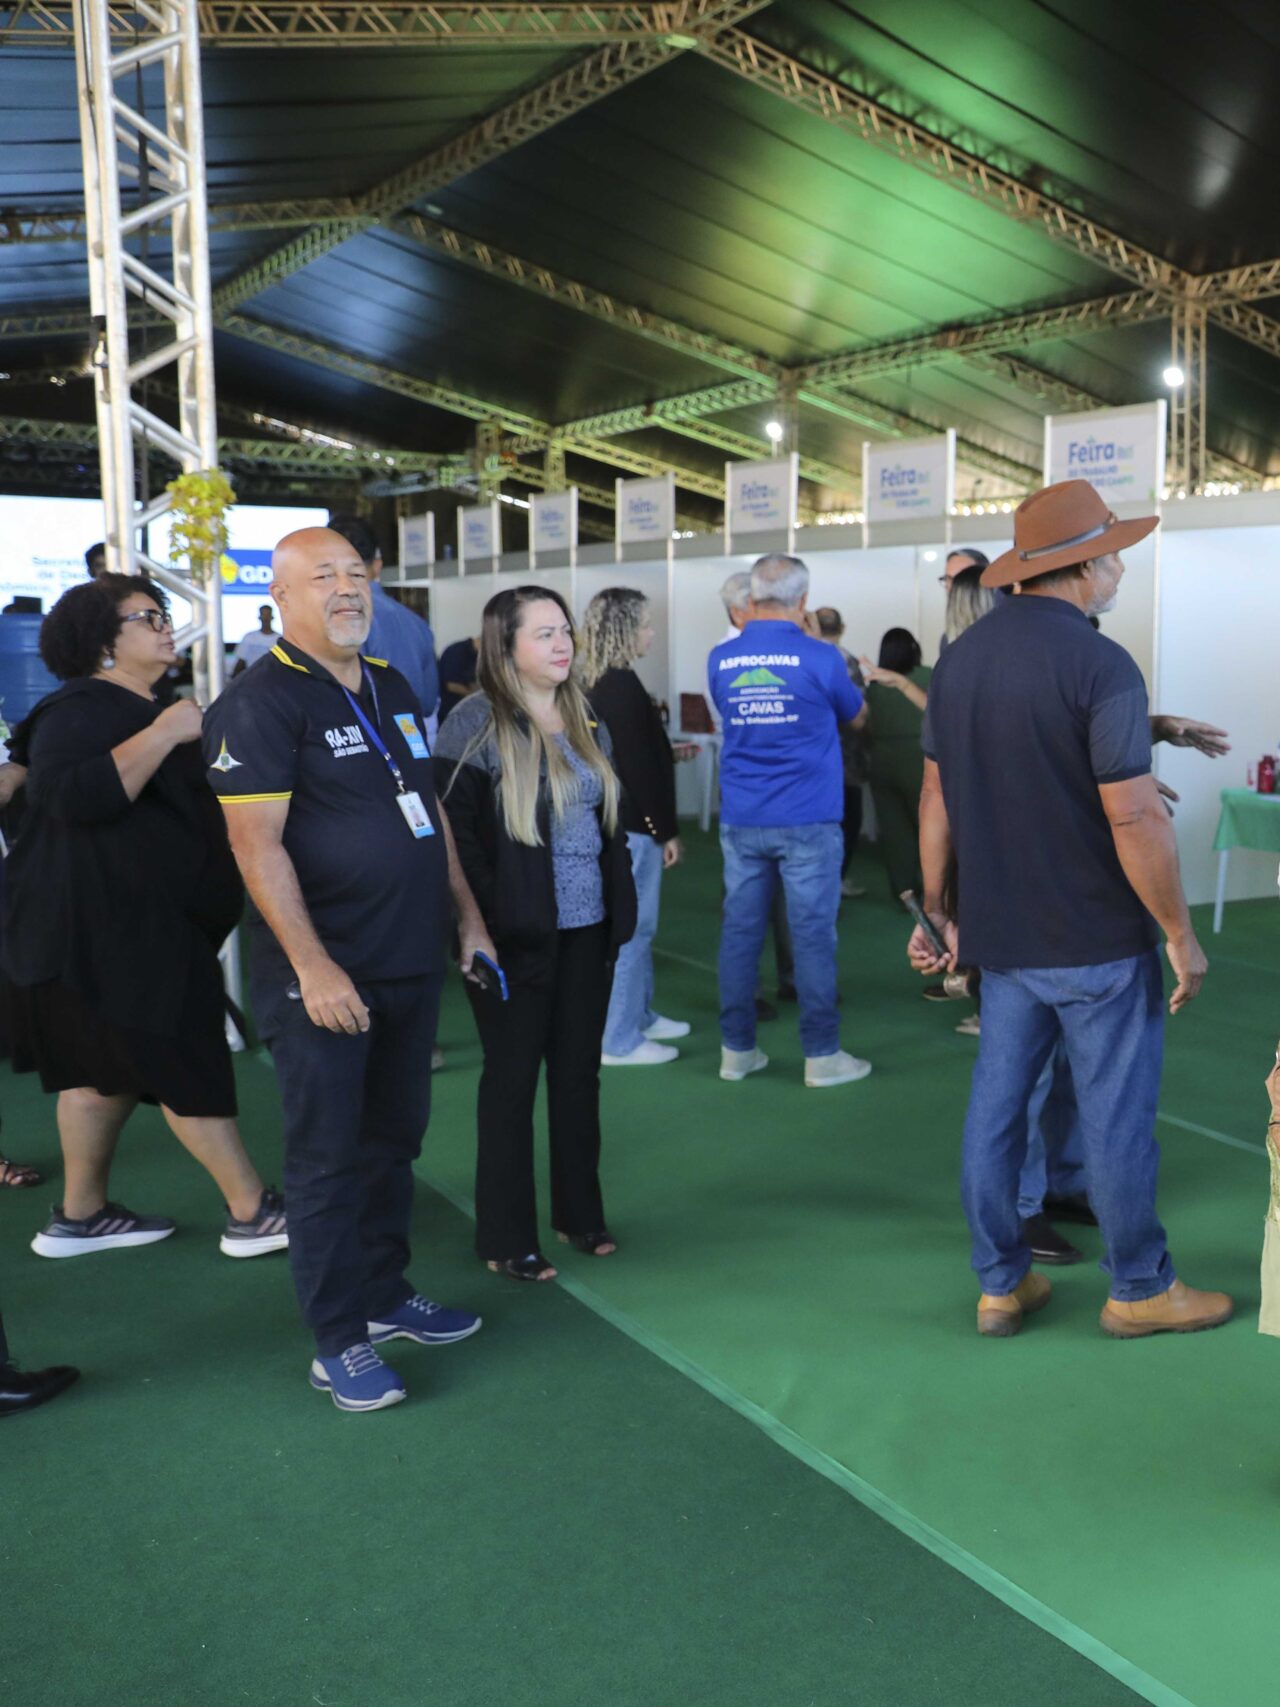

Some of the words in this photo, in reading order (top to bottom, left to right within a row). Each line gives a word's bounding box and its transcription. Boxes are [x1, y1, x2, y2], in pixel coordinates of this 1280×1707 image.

[1068, 441, 1115, 464] Feira
[240, 565, 273, 584] GD
[719, 655, 800, 671] ASPROCAVAS
[738, 701, 785, 715] CAVAS
